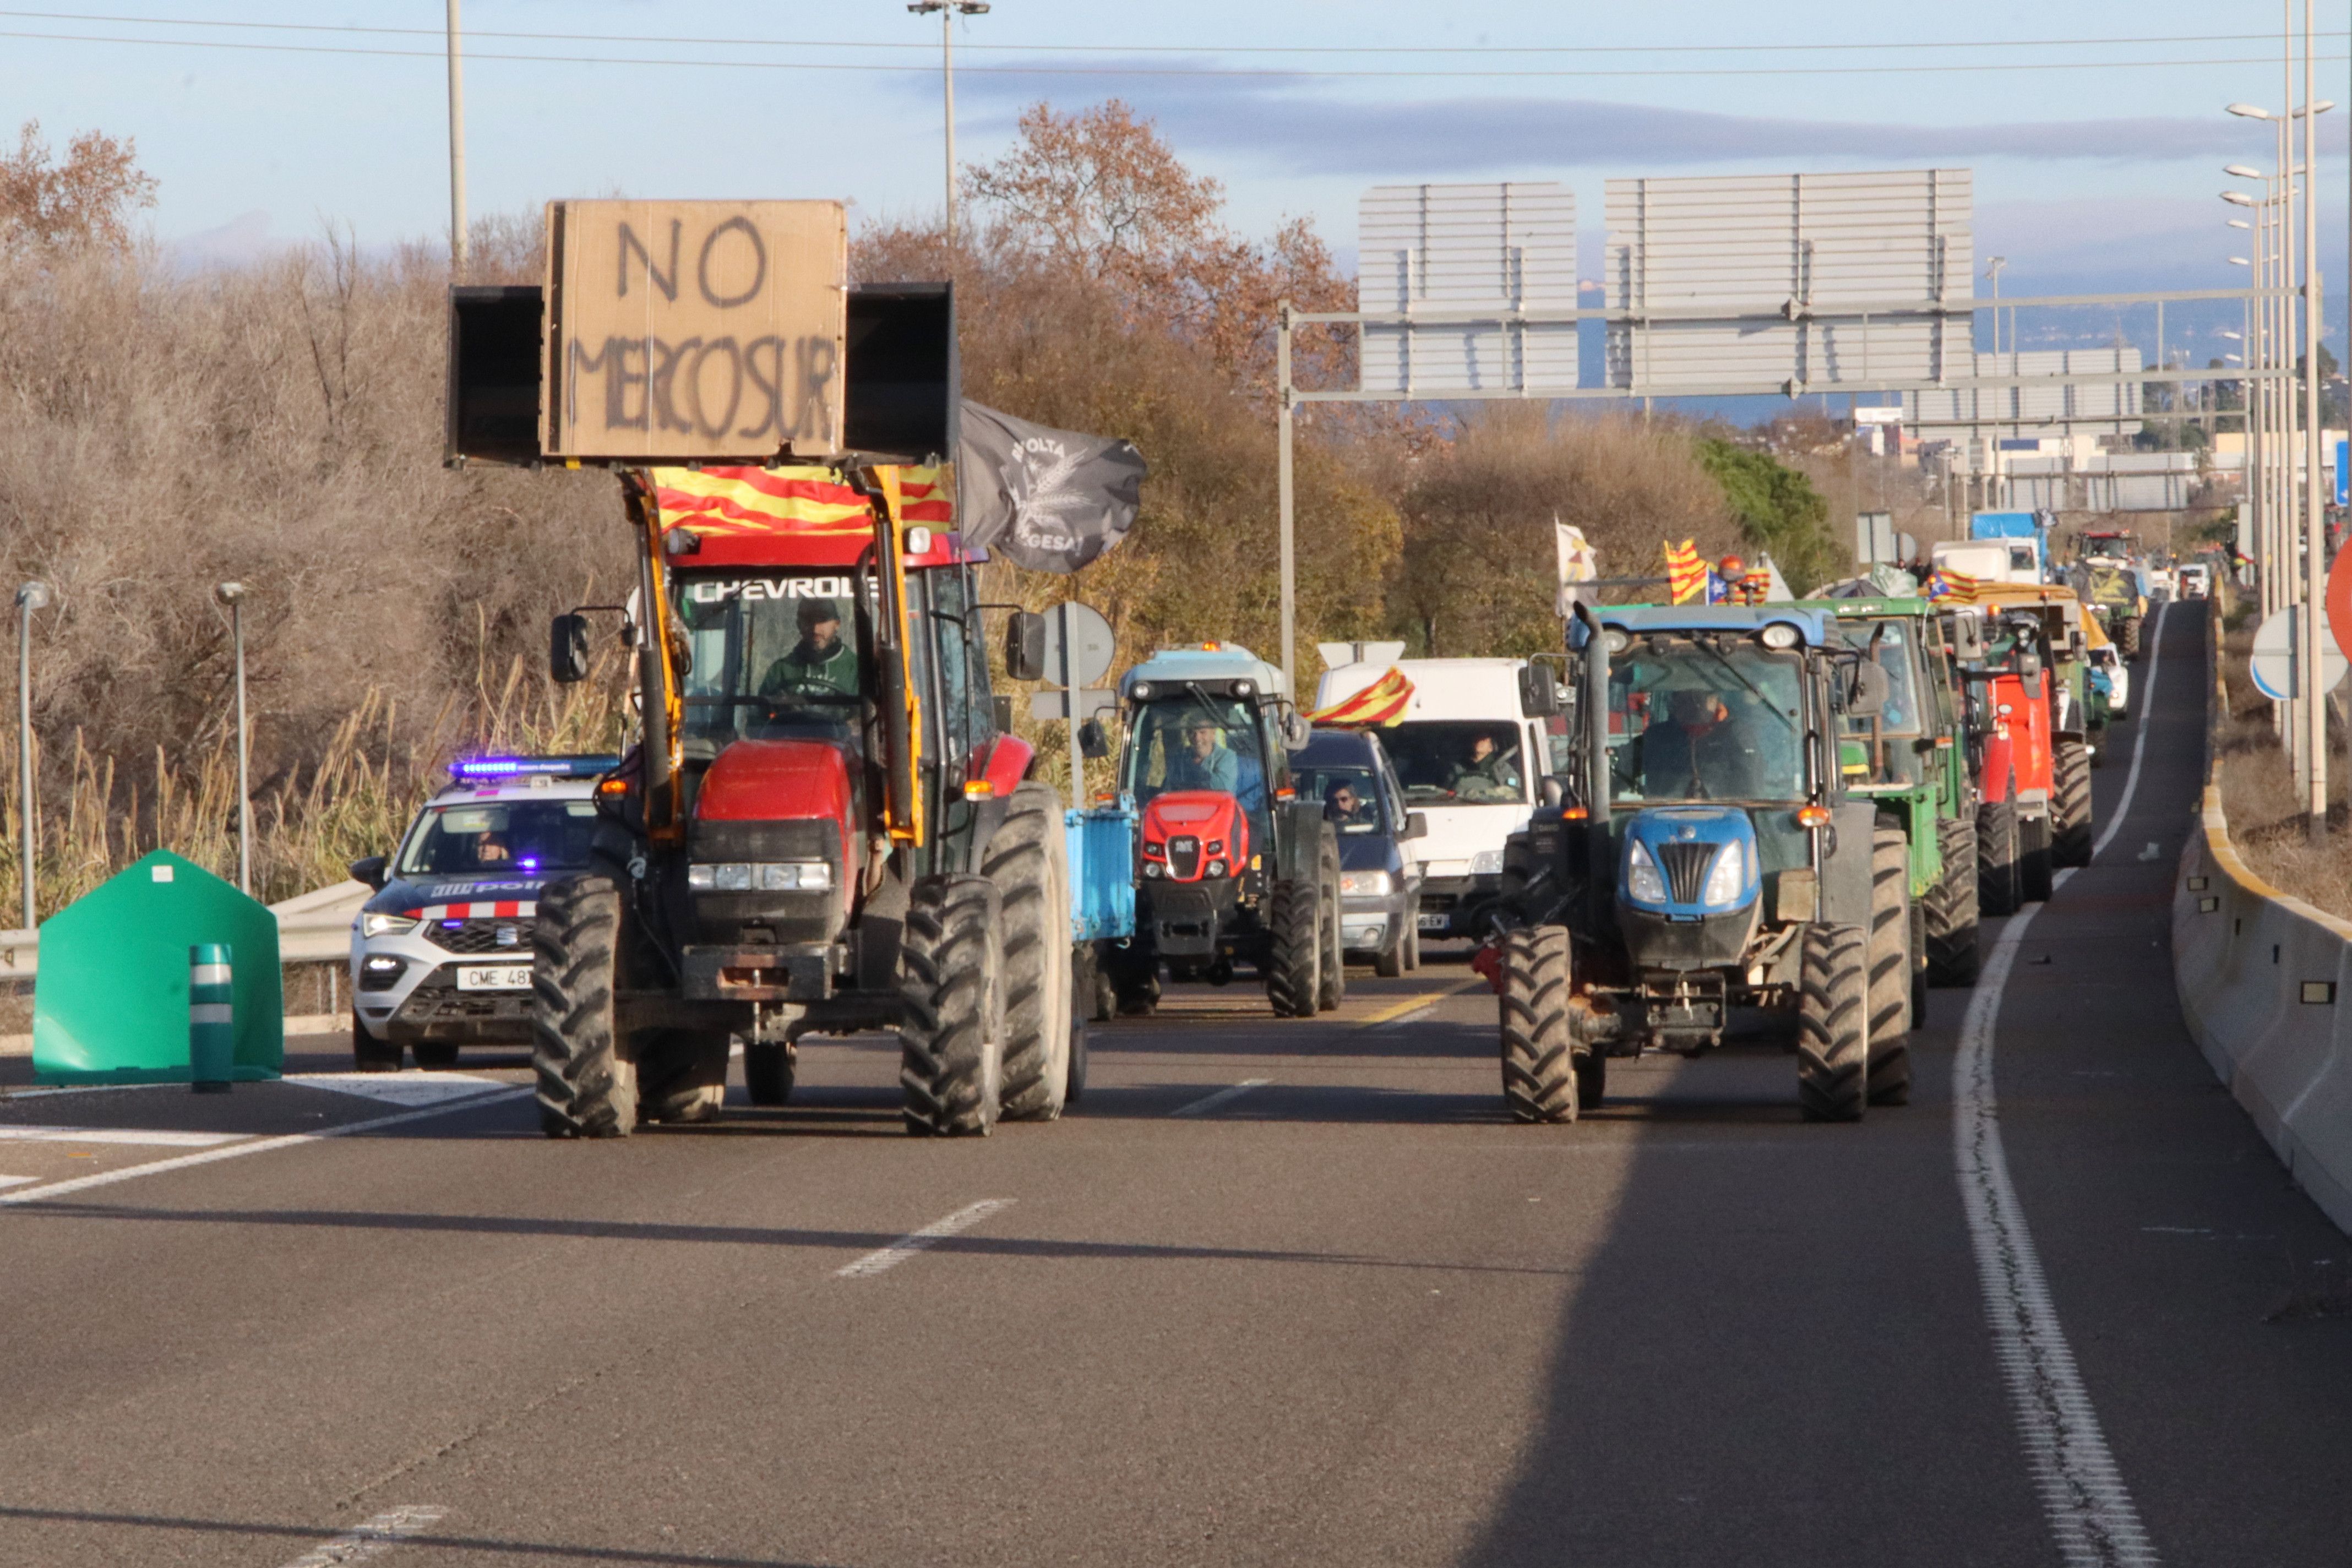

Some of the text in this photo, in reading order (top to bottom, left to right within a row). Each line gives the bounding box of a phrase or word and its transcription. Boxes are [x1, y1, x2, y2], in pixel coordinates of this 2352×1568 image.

[618, 215, 766, 309] NO
[567, 334, 837, 442] MERCOSUR
[694, 576, 880, 603] CHEVROLE
[470, 971, 498, 986] CME
